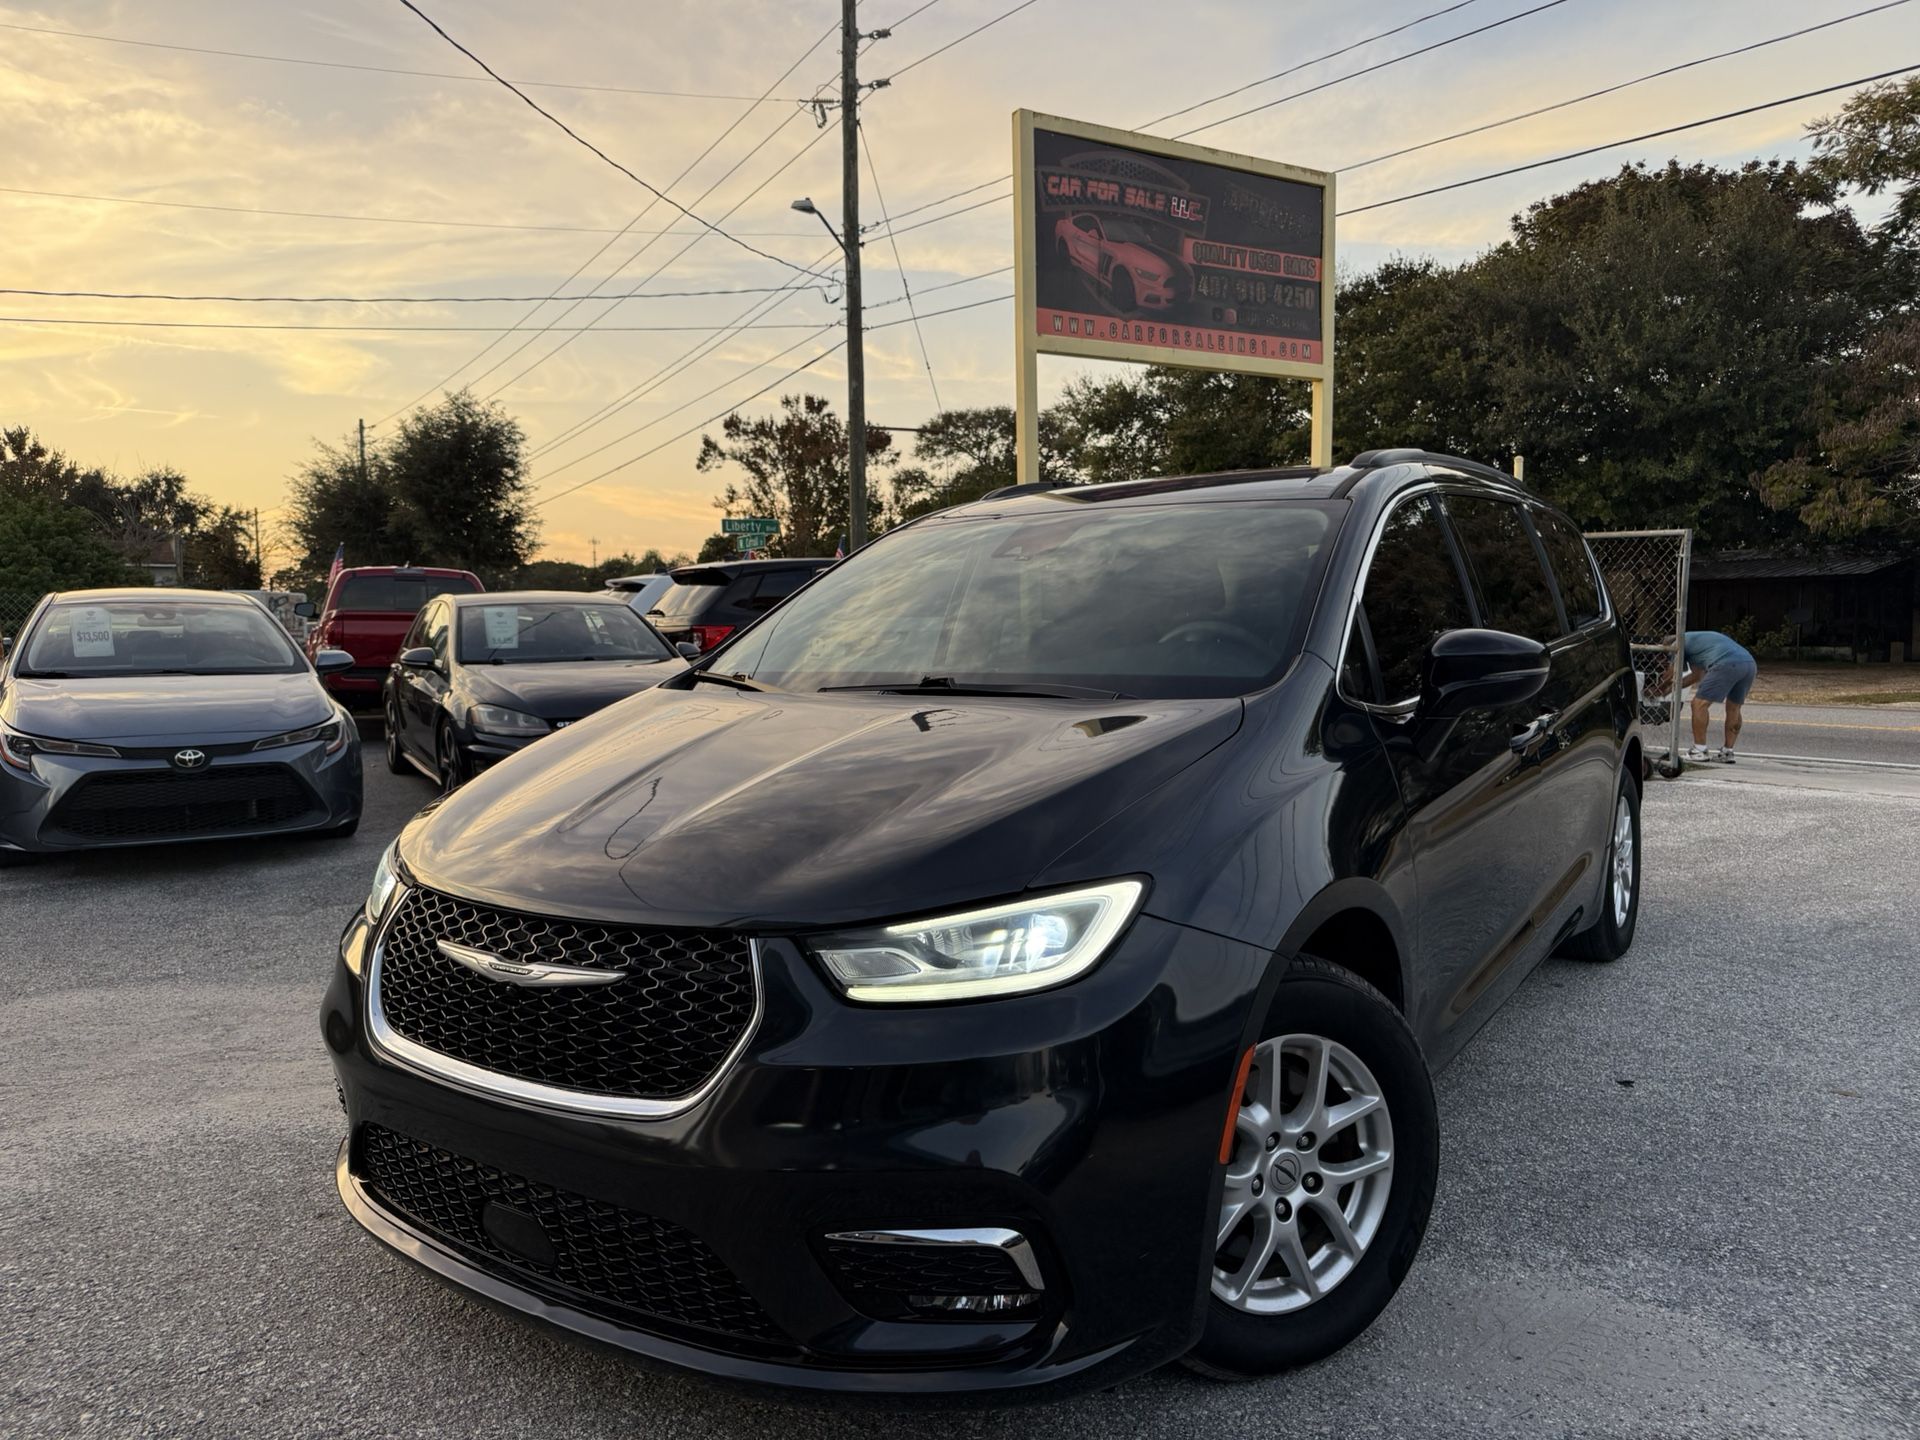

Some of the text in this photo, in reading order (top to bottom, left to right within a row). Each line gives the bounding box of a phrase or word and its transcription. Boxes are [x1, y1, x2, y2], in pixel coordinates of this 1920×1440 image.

[1047, 175, 1081, 198] CAR
[1087, 180, 1120, 203] FOR
[1124, 187, 1165, 211] SALE
[1170, 196, 1203, 221] LLC
[1193, 241, 1316, 278] QUALITY USED CARS
[1197, 273, 1228, 299] 407
[1273, 284, 1316, 311] 4250
[1053, 314, 1312, 359] WWW.CARFORSALEINC1.COM
[725, 520, 761, 533] Liberty
[76, 630, 110, 643] $13,500
